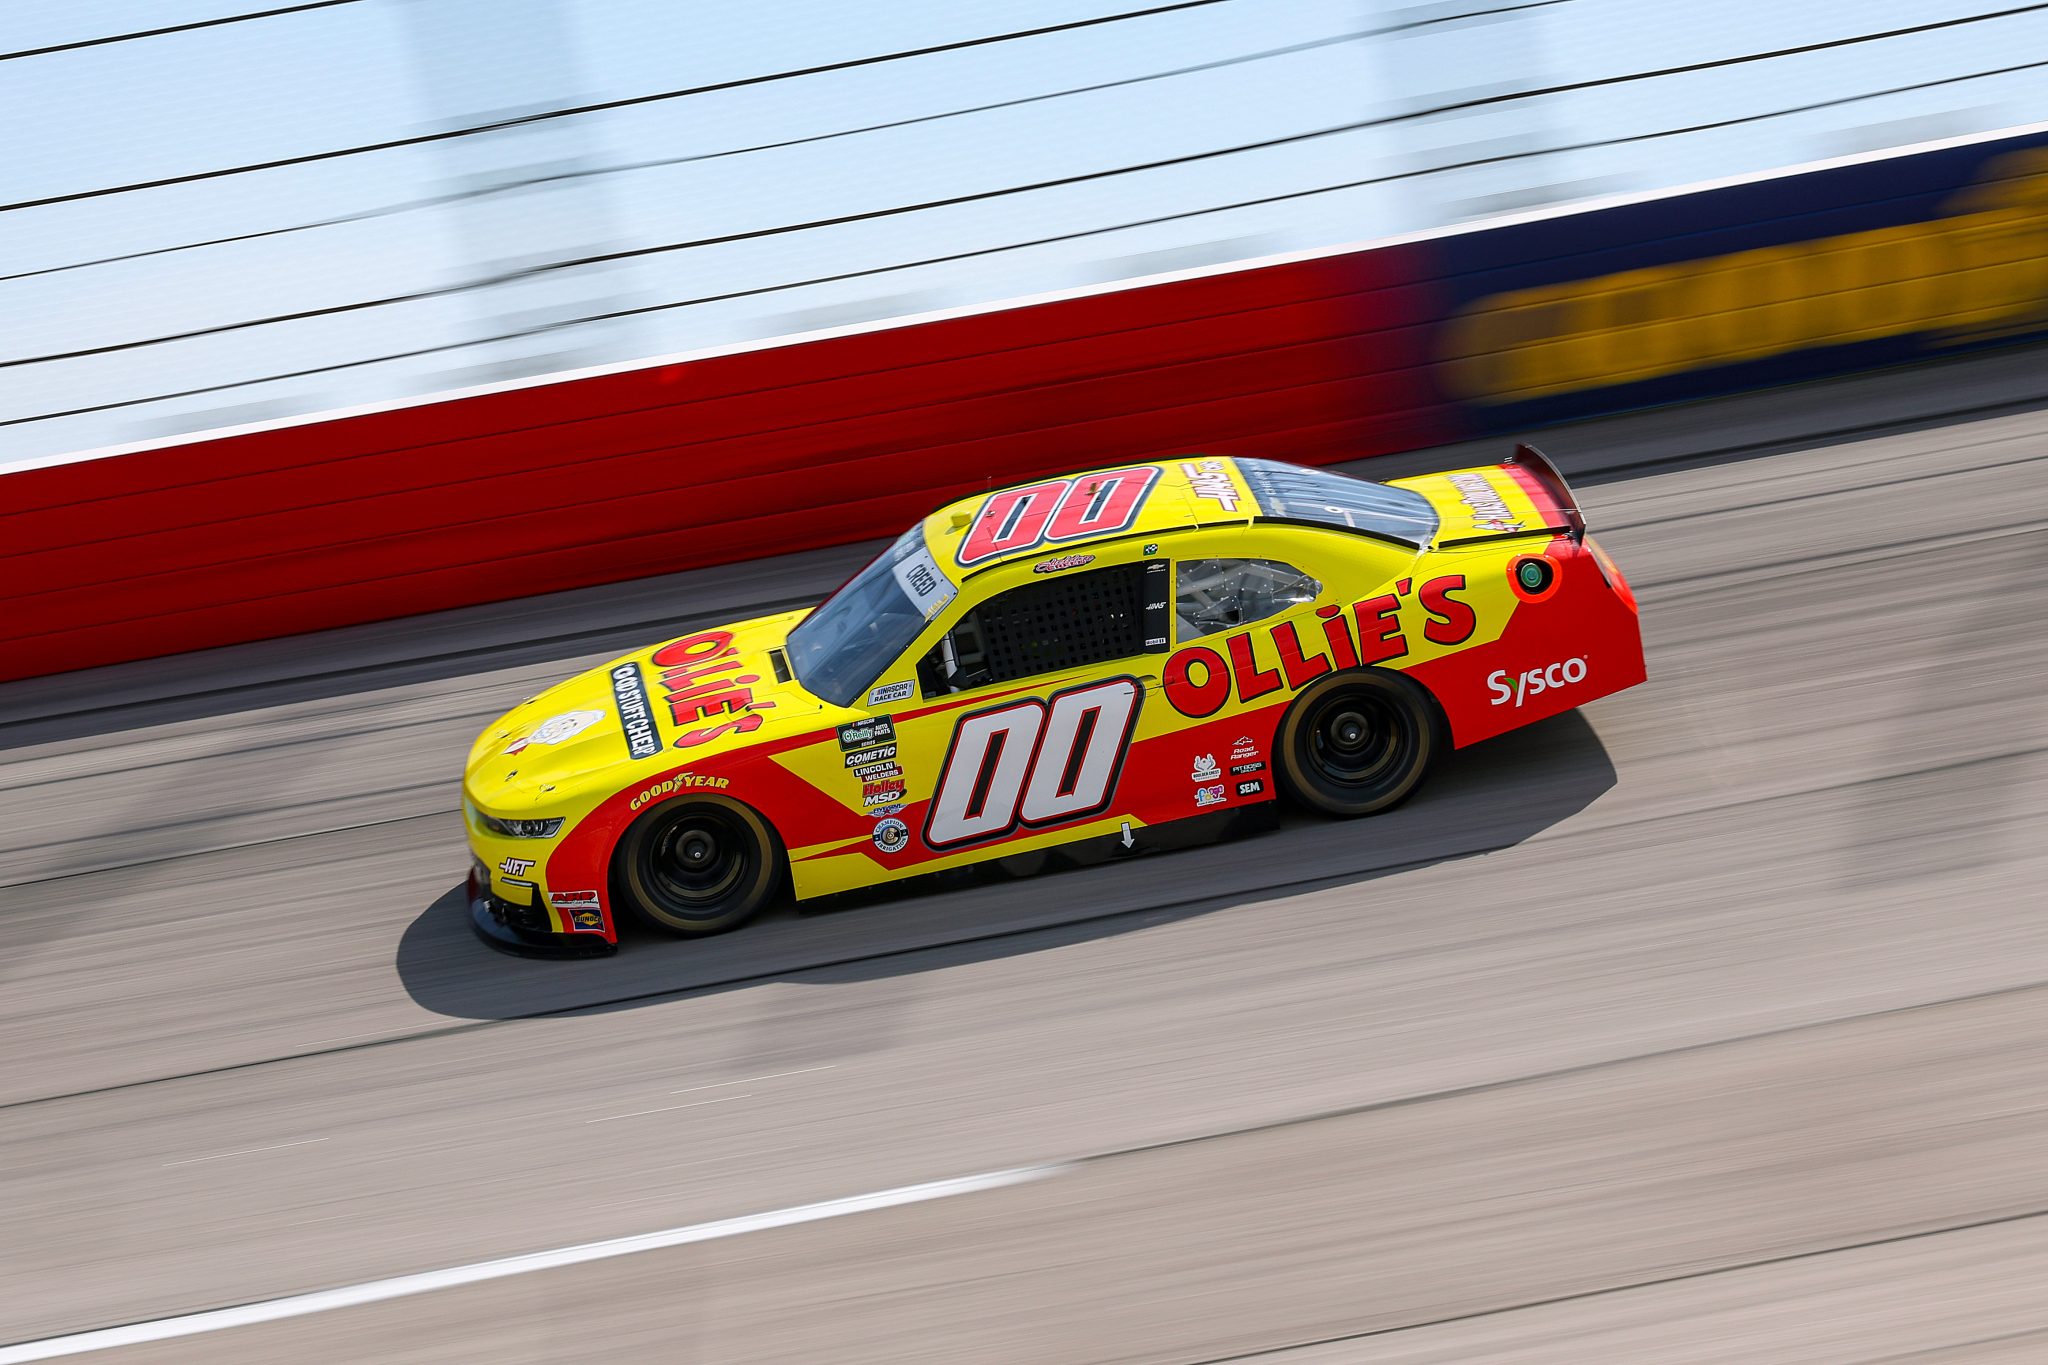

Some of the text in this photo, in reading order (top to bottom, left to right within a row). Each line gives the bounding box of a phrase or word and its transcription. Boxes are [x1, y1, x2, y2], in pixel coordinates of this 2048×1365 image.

[955, 466, 1161, 566] 00
[906, 563, 937, 597] CREED
[878, 683, 908, 695] NASCAR
[1487, 658, 1587, 707] Sysco
[874, 690, 907, 702] RACE CAR
[618, 689, 646, 720] STUFF
[843, 728, 874, 742] O'Reilly
[875, 727, 891, 736] PARTS
[1230, 751, 1258, 760] Ranger
[1234, 746, 1254, 754] Road
[855, 762, 894, 776] LINCOLN
[924, 677, 1142, 848] 00
[865, 769, 899, 781] WELDERS
[863, 779, 905, 796] Holley
[1240, 782, 1260, 794] SEM
[864, 791, 900, 806] MSD
[875, 819, 904, 833] CHAMPION
[877, 837, 907, 851] IRRIGATION
